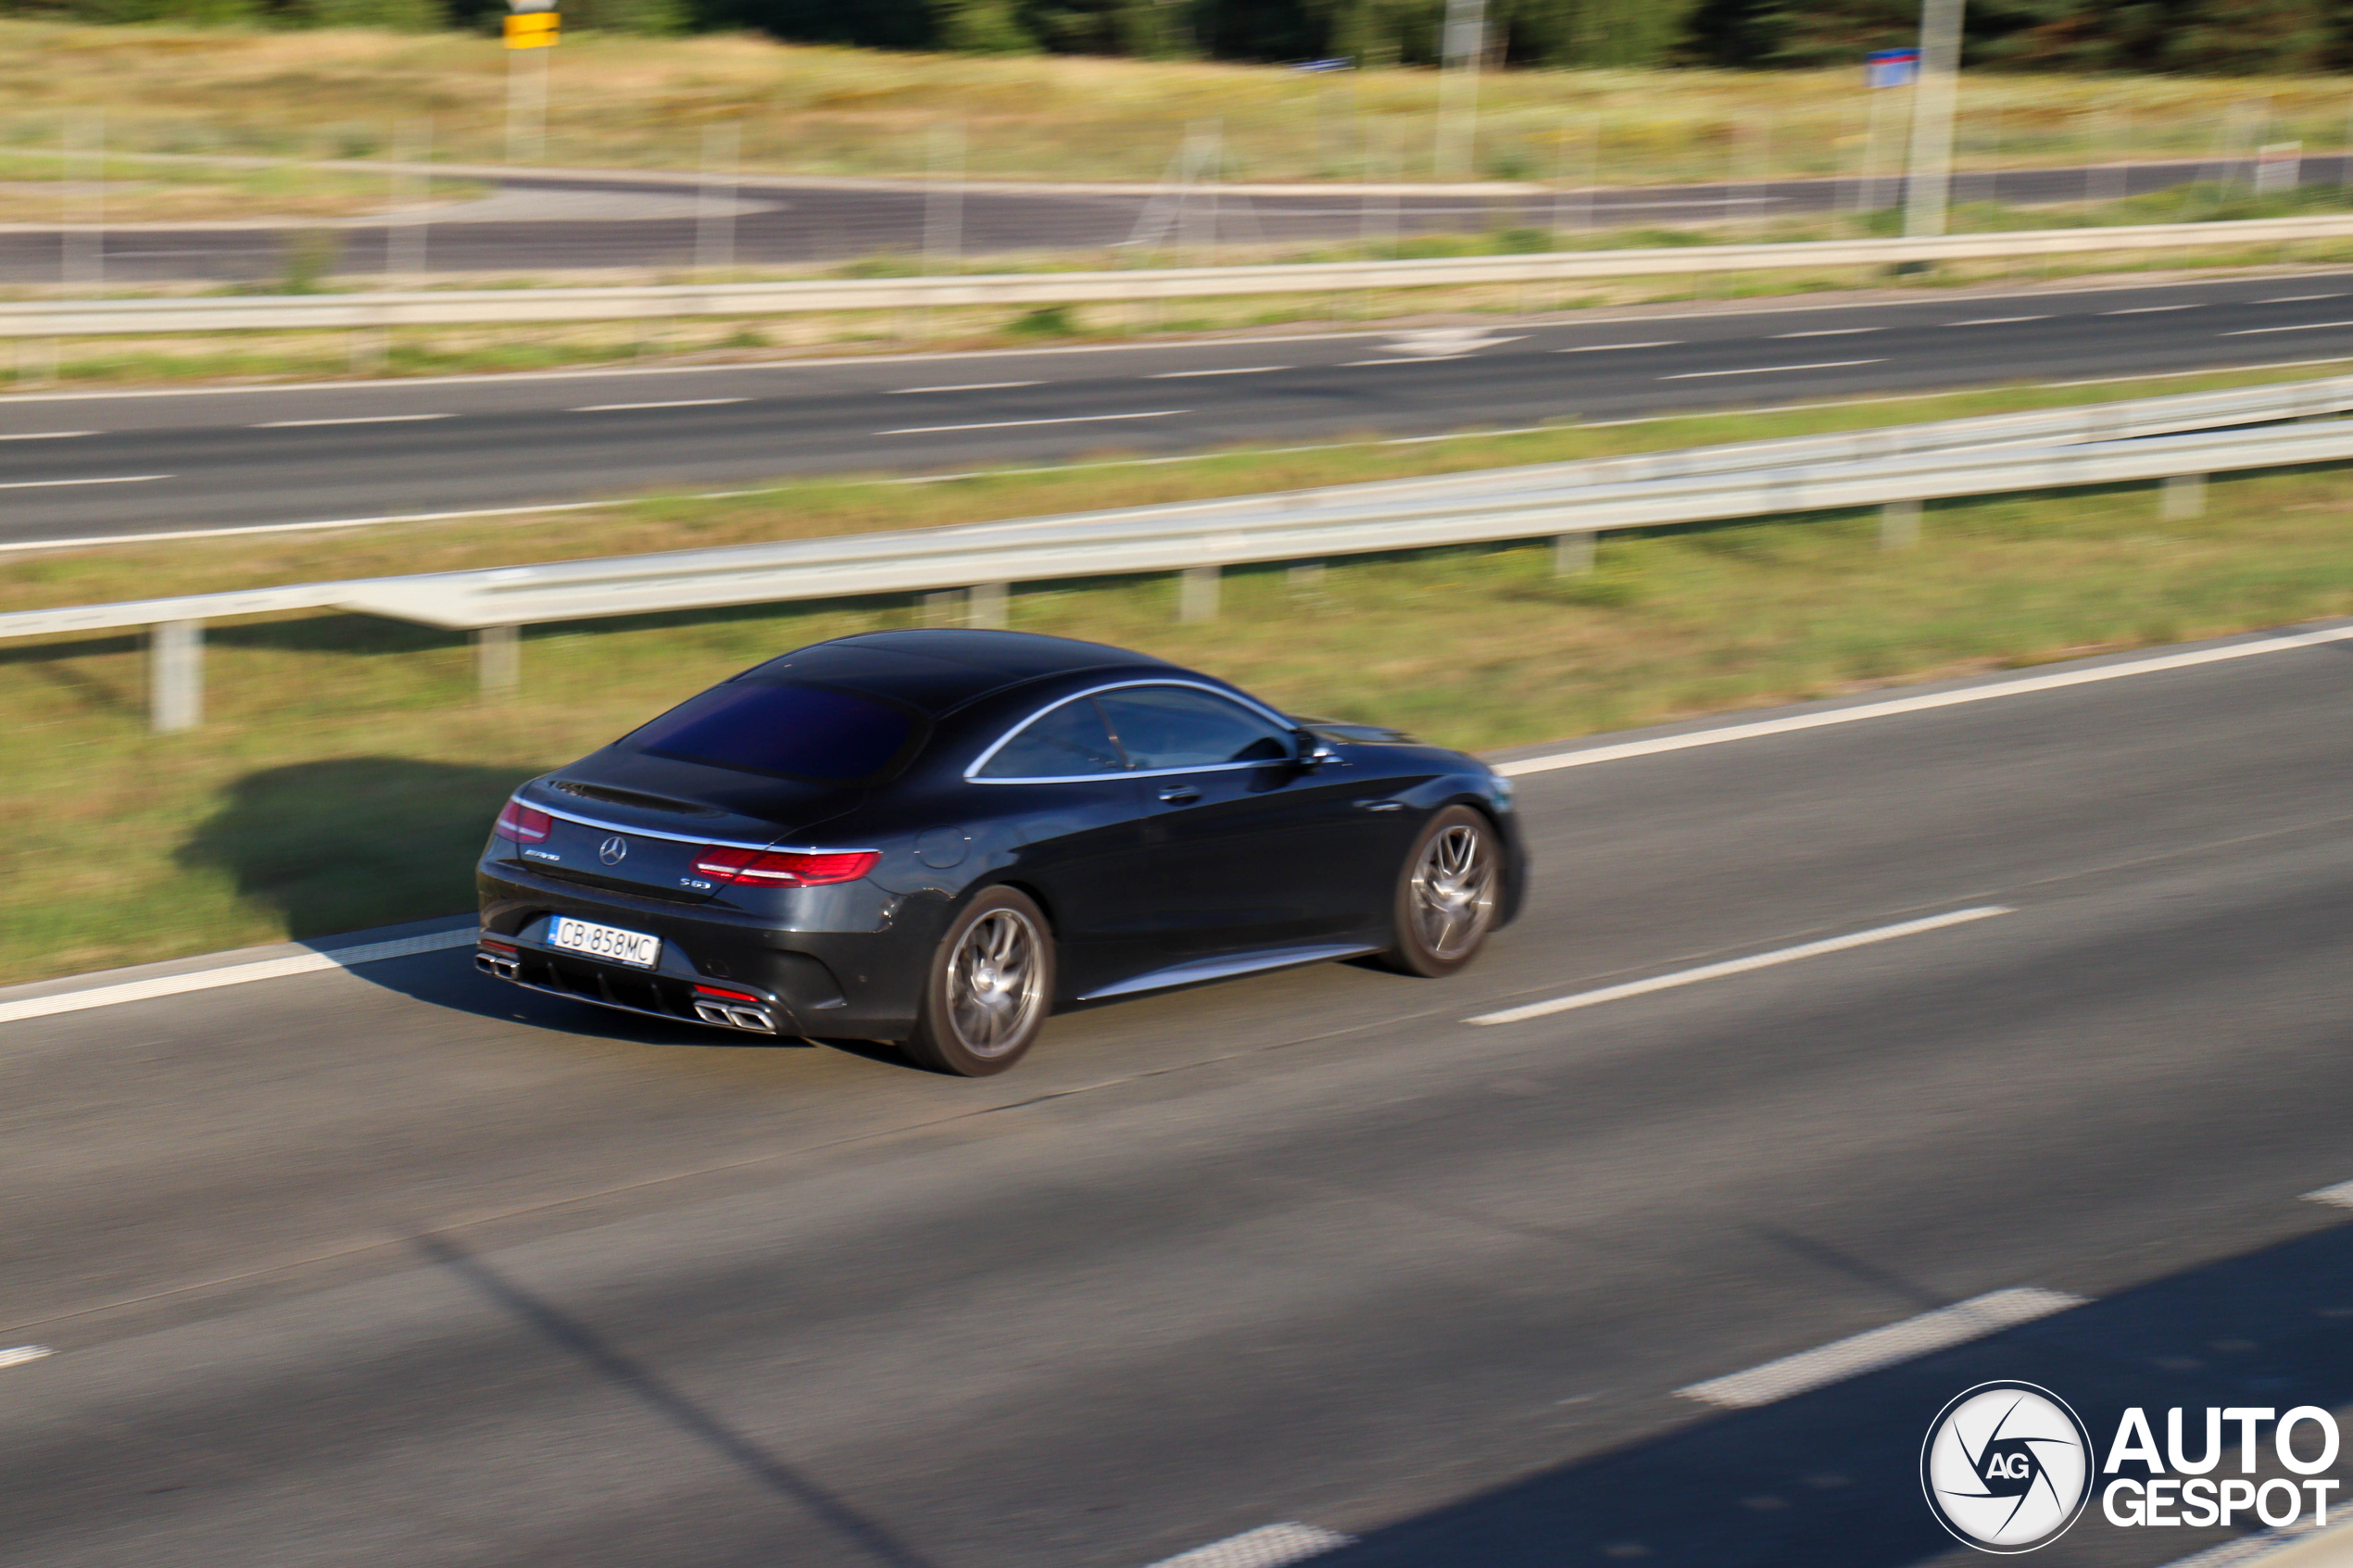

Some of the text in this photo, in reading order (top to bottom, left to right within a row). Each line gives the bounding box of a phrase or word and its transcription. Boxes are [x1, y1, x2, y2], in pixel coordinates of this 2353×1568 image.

[691, 880, 711, 889] 63
[560, 922, 585, 947] CB
[590, 928, 652, 961] 858MC
